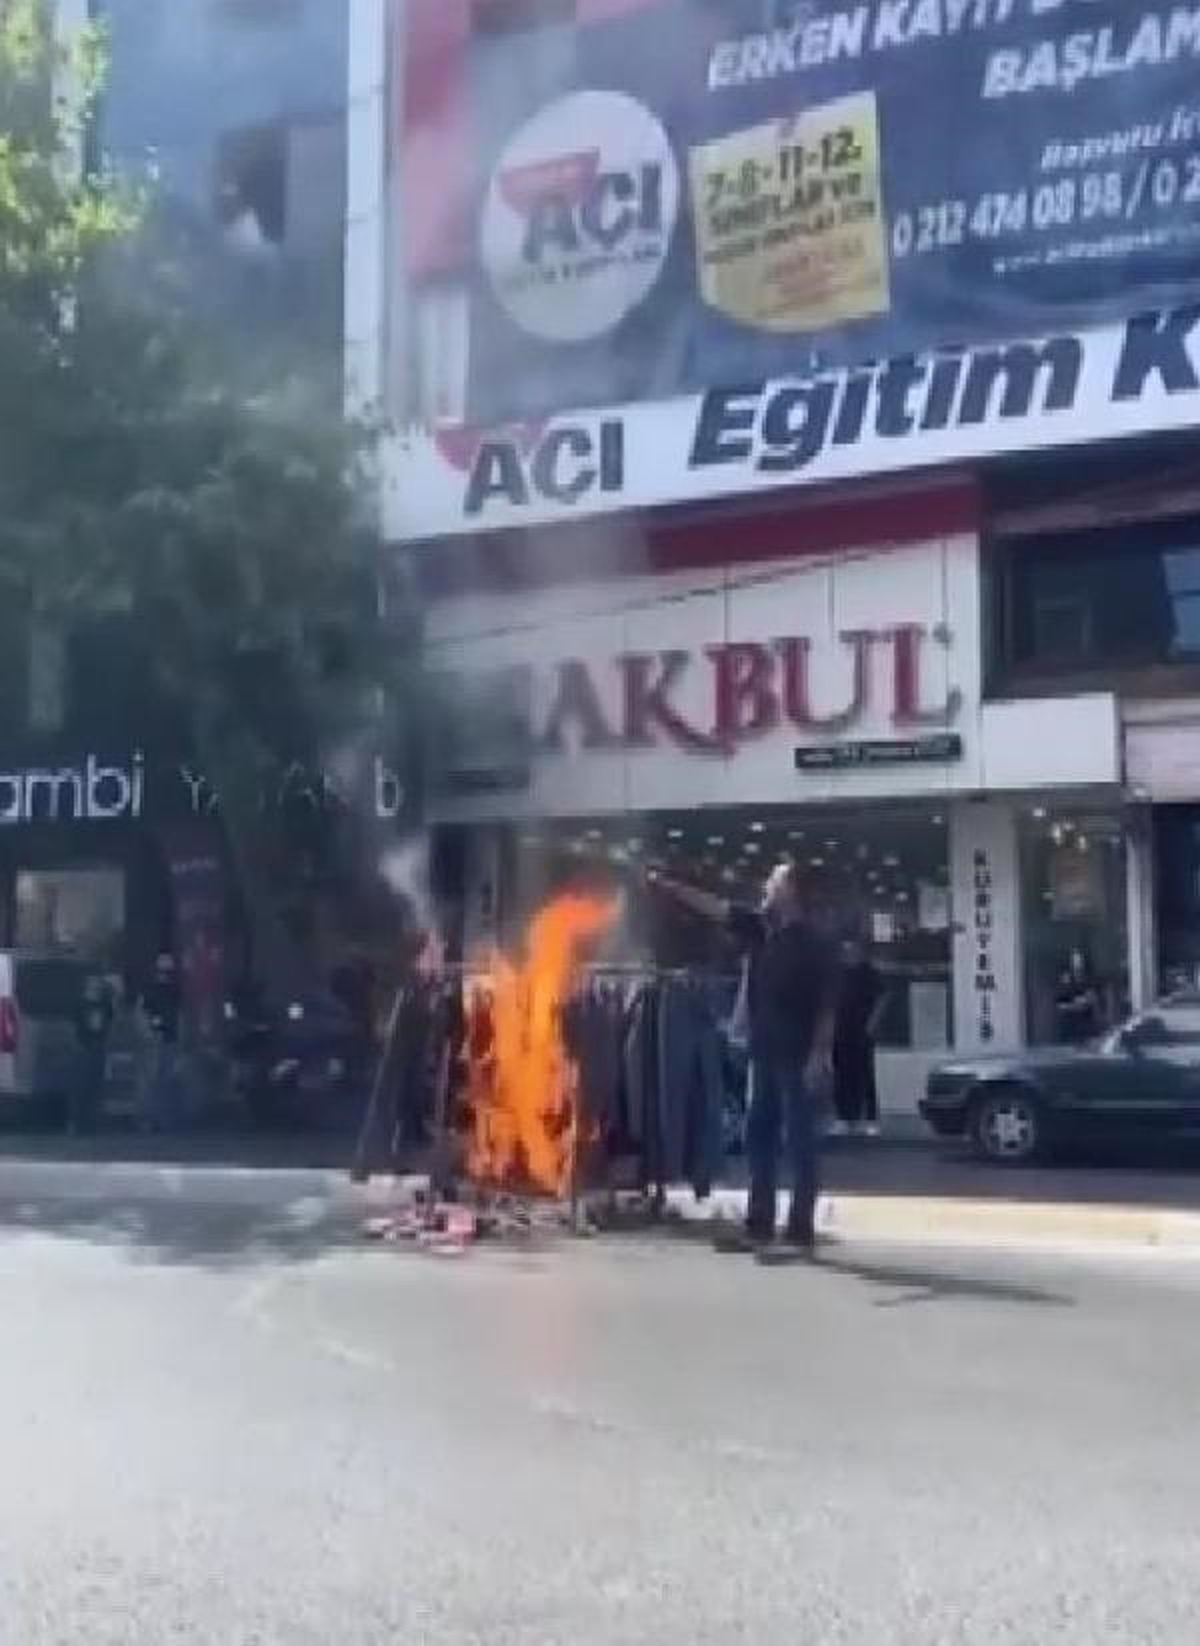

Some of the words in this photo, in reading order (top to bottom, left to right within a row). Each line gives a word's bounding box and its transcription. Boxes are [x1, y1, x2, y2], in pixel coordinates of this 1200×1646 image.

[708, 5, 869, 91] ERKEN
[893, 213, 914, 257] 0
[917, 200, 967, 252] 212
[1154, 159, 1180, 203] 0
[463, 420, 625, 518] ACI
[688, 334, 1083, 472] Eğitim
